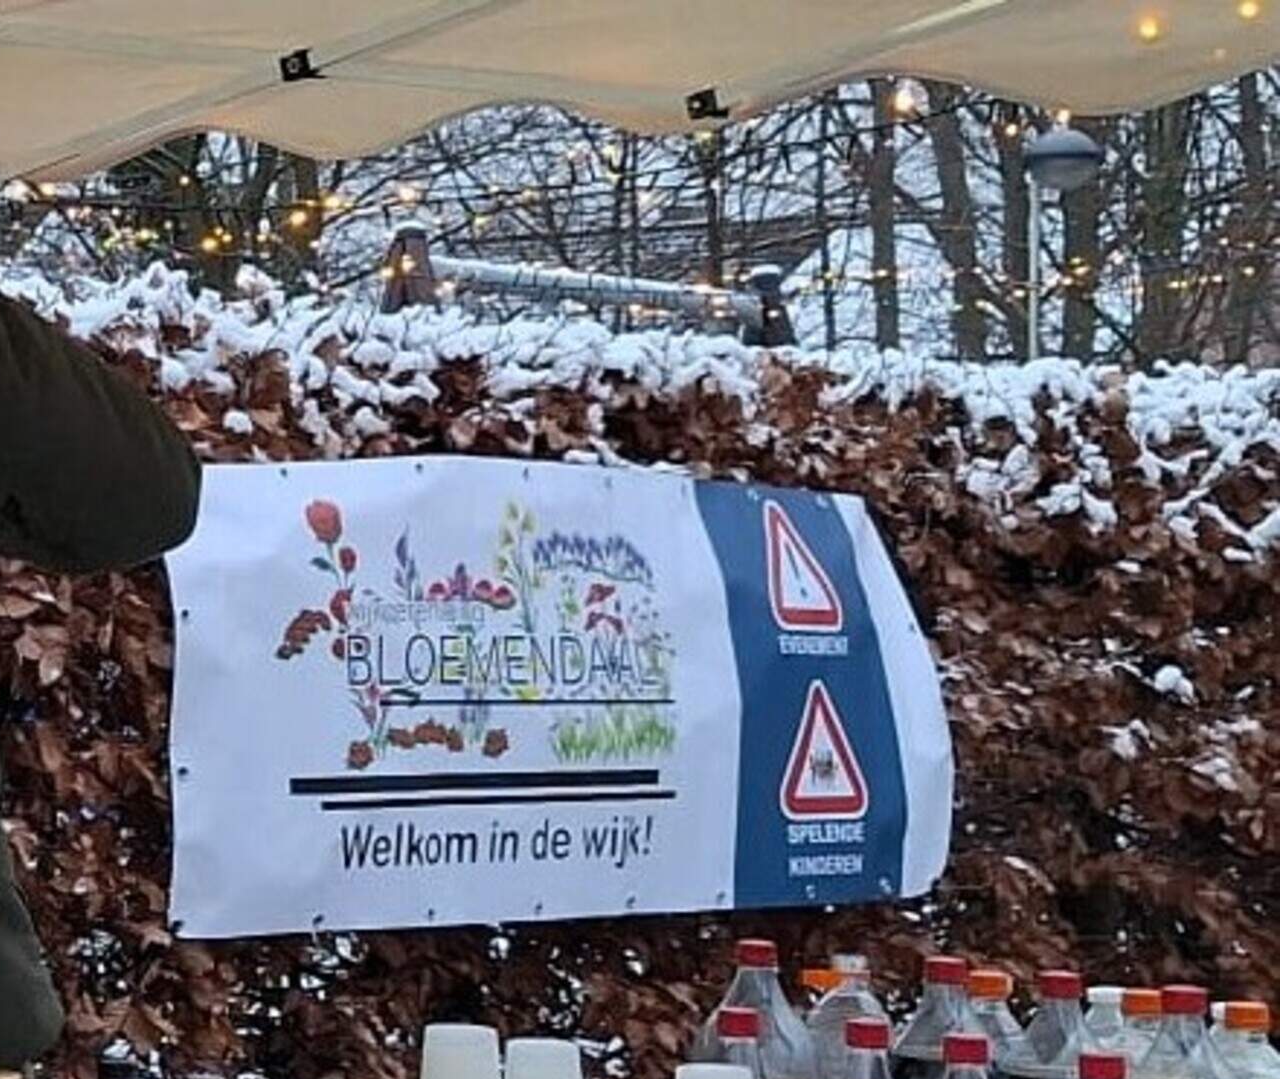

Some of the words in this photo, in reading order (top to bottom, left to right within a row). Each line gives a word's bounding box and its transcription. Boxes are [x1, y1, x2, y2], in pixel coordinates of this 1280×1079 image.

[347, 634, 657, 687] BLOEMENDAAL
[341, 821, 478, 869] Welkom
[488, 820, 520, 863] in
[531, 818, 572, 860] de
[583, 815, 653, 869] wijk!
